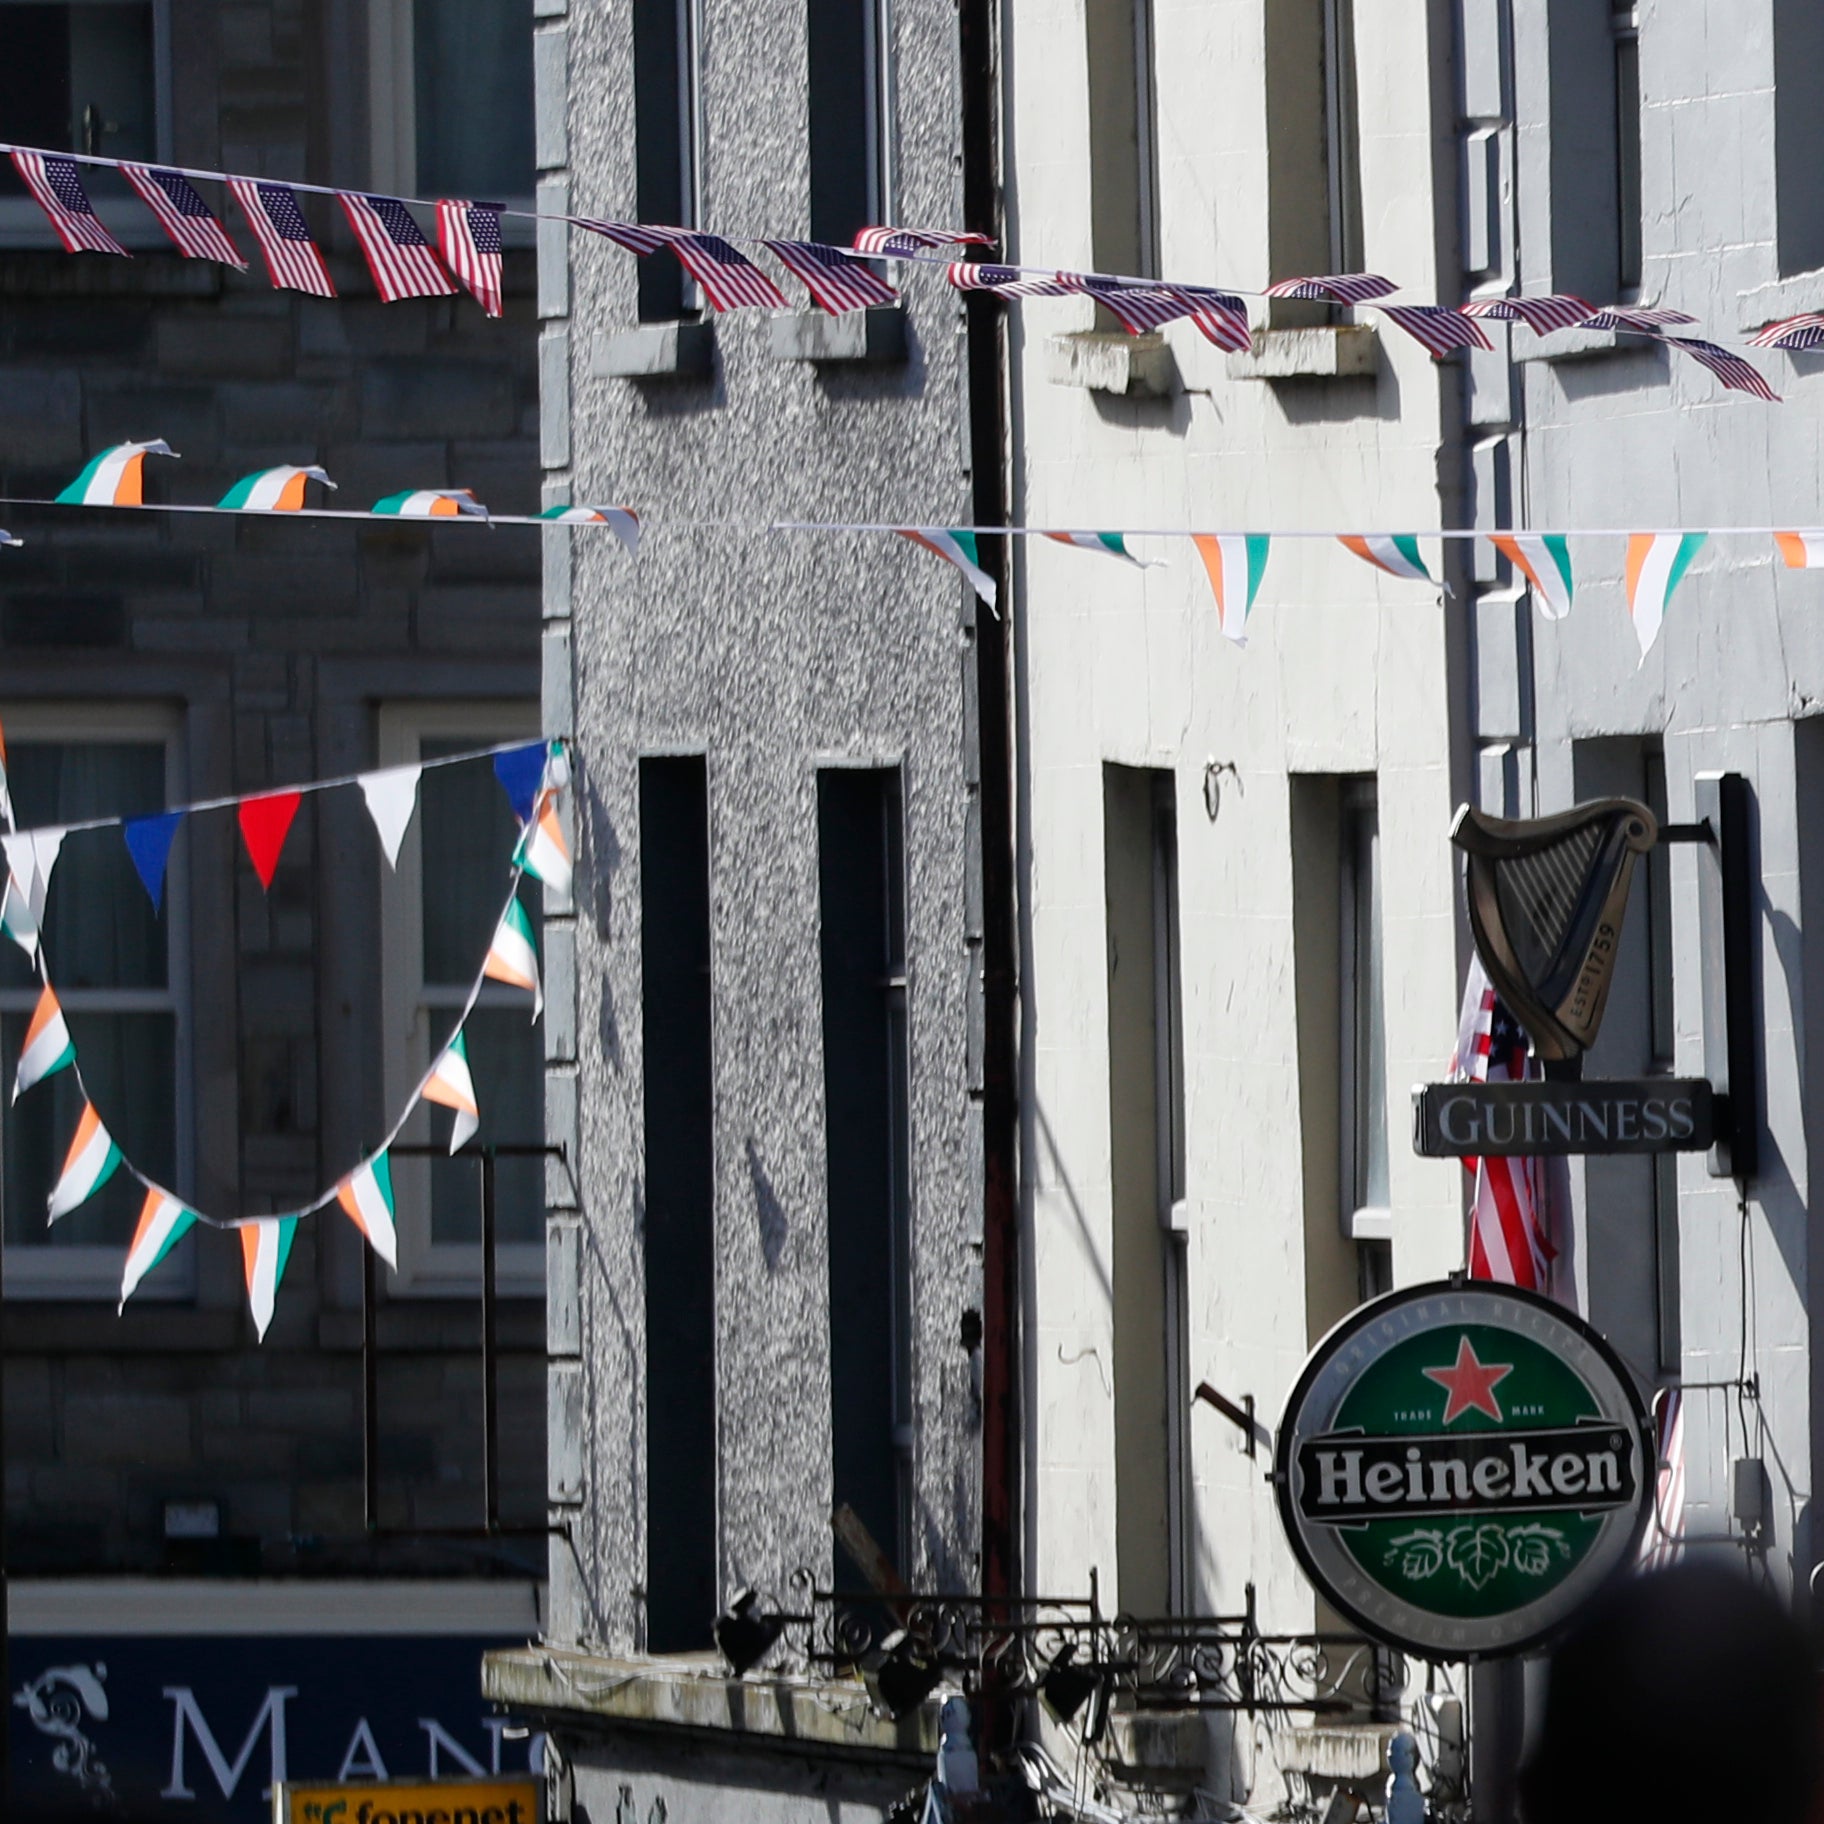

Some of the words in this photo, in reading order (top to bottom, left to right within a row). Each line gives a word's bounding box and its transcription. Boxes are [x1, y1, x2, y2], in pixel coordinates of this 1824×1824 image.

[1585, 923, 1614, 974] 1759
[1438, 1095, 1695, 1146] GUINNESS
[1334, 1299, 1468, 1376] ORIGINAL
[1511, 1404, 1545, 1417] MARK
[1315, 1441, 1622, 1505] Heineken
